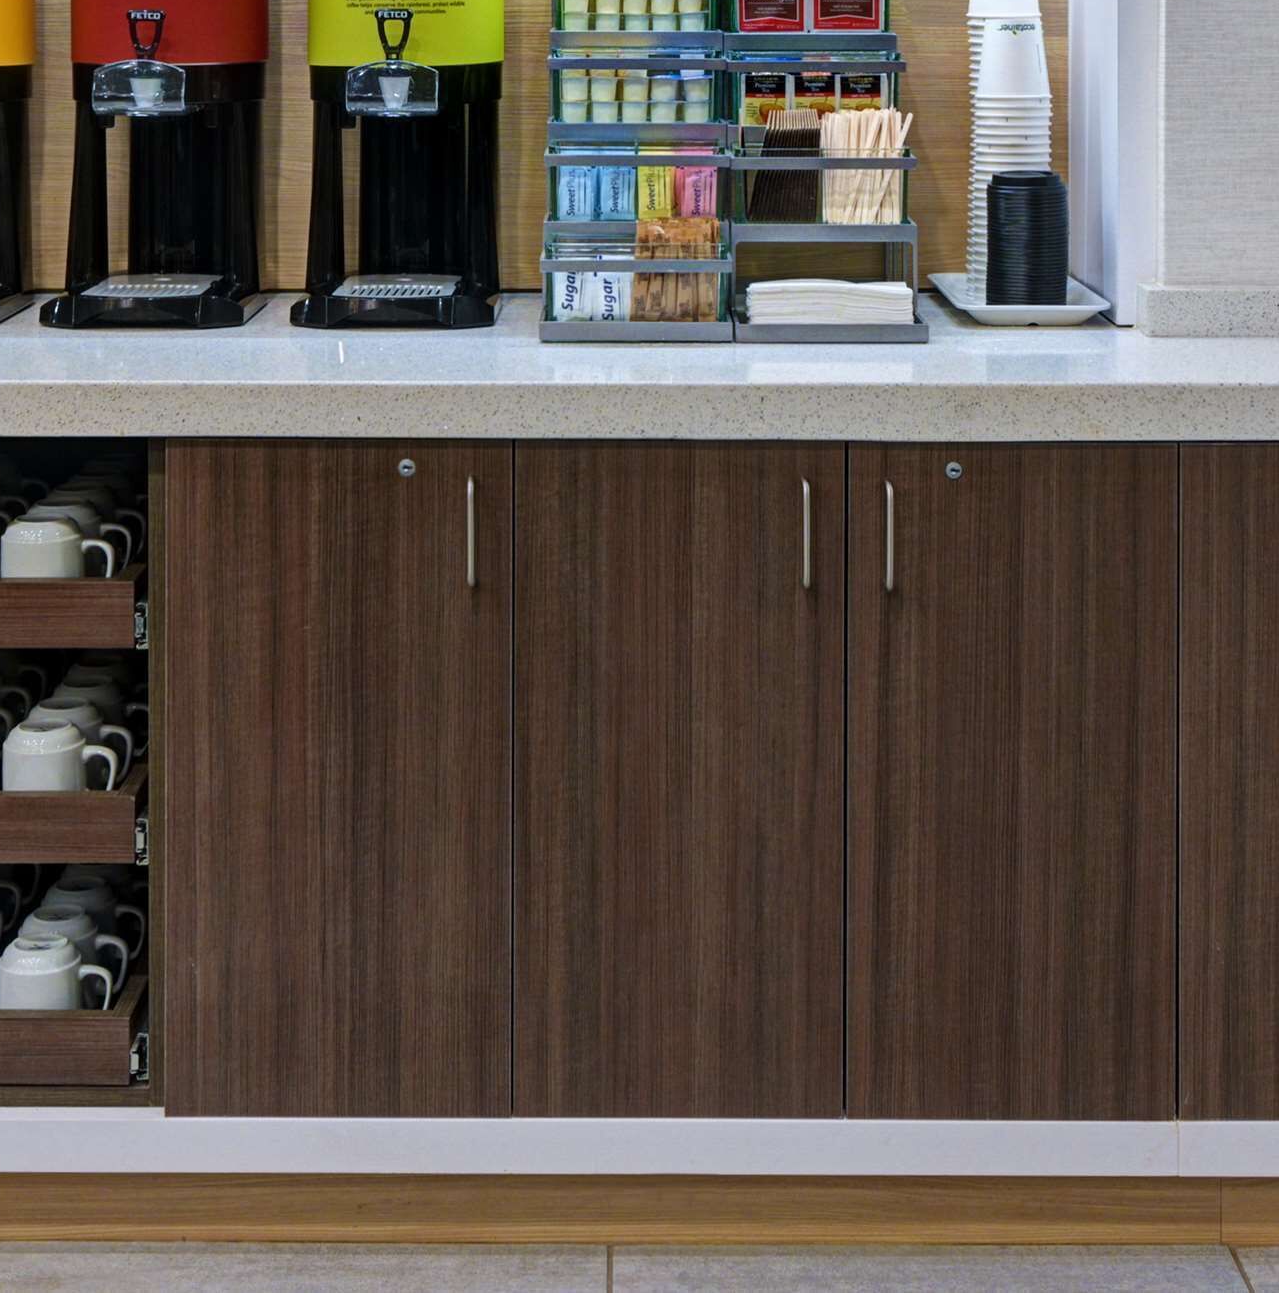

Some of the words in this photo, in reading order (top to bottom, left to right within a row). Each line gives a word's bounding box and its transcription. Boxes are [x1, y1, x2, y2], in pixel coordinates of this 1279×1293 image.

[131, 11, 162, 20] FETCO
[377, 10, 409, 19] FETCO
[601, 277, 617, 320] Sugar
